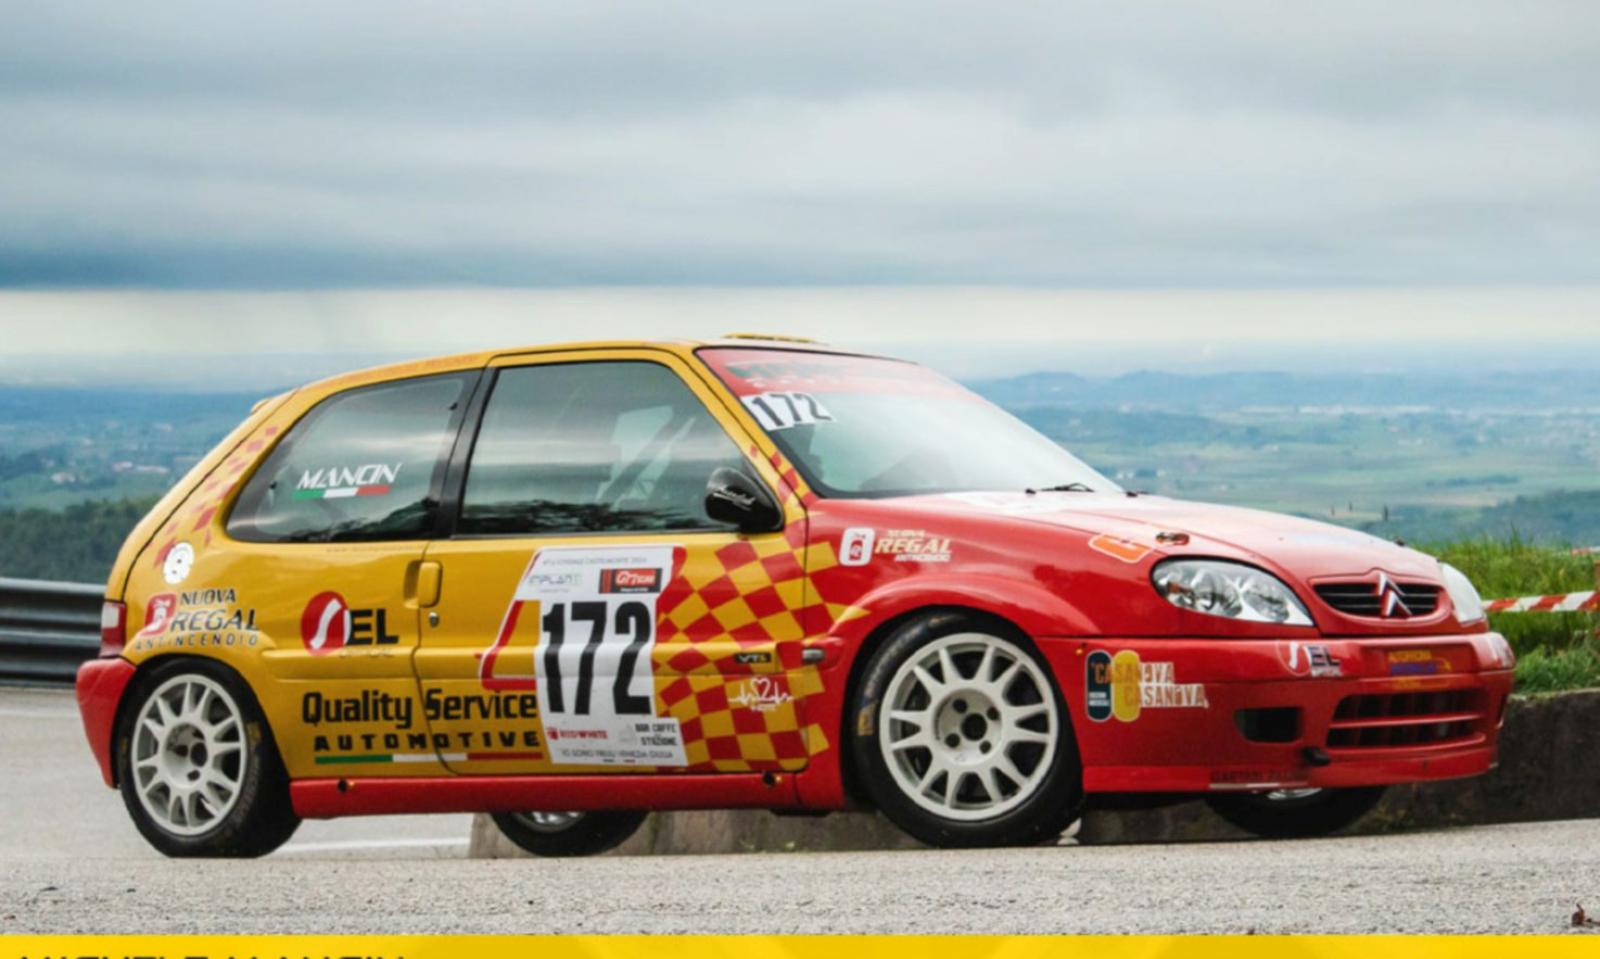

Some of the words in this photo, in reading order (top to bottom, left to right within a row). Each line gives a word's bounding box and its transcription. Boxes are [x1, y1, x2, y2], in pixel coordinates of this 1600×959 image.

[752, 394, 832, 426] 172
[875, 539, 951, 554] REGAL
[180, 588, 237, 605] NUOVA
[170, 608, 259, 632] REGAL
[136, 633, 258, 650] ANTINCENDIO
[542, 601, 652, 716] 172
[303, 690, 412, 729] Quality
[425, 688, 537, 720] Service
[314, 731, 540, 751] AUTOMOTIVE
